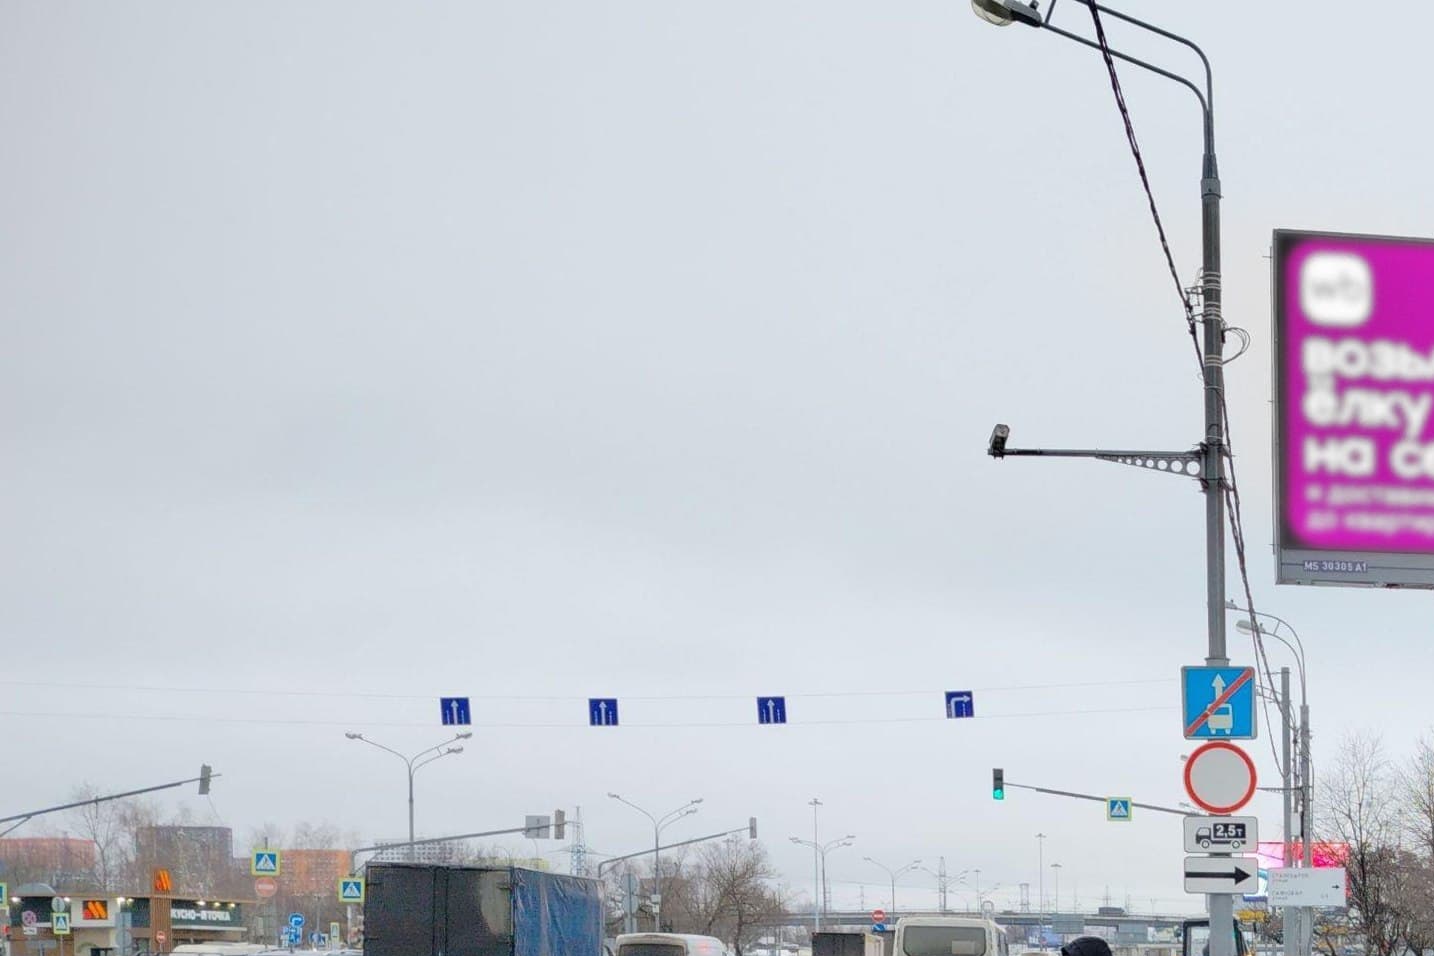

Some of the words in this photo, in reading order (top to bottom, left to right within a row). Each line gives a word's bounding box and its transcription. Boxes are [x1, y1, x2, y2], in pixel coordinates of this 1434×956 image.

[1303, 374, 1434, 445] ёлку
[1303, 436, 1376, 476] на
[170, 908, 196, 920] КУСНО
